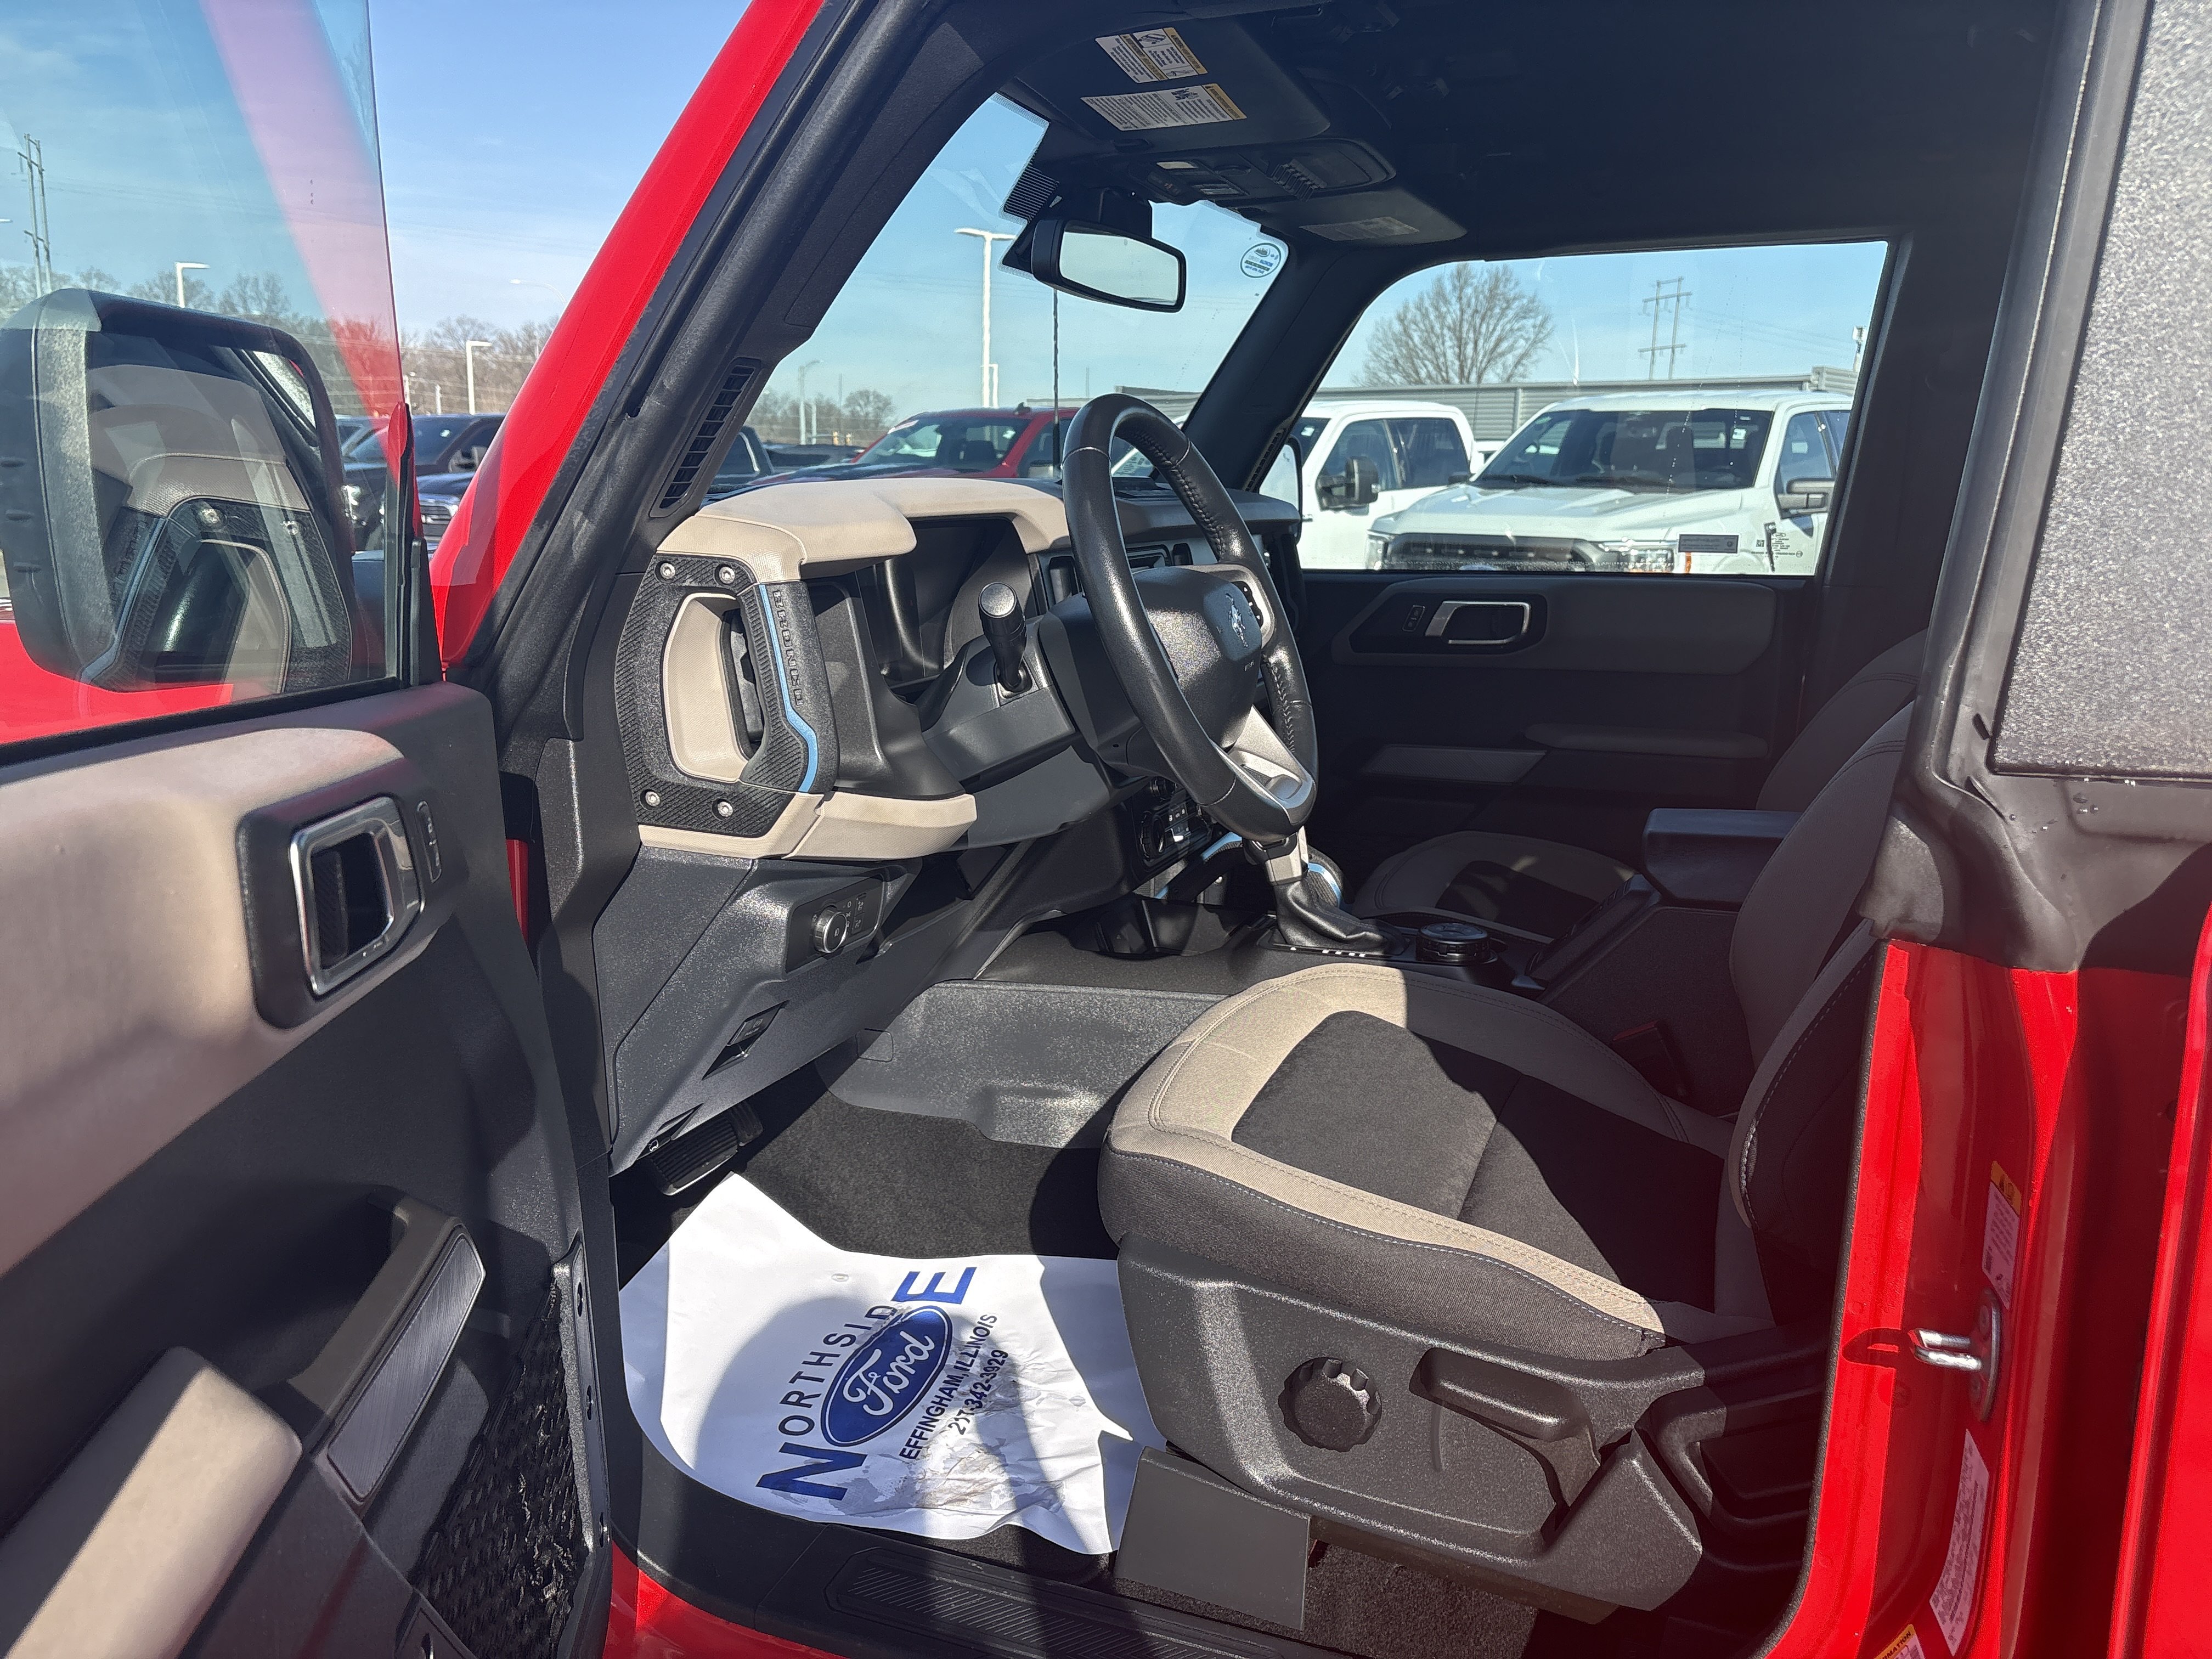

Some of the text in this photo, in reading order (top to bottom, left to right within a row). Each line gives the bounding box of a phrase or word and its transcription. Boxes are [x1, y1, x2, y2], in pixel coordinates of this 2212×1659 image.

[773, 590, 804, 706] BRONCO
[756, 1267, 977, 1500] NORTHSIDE
[843, 1331, 934, 1415] Ford
[899, 1314, 997, 1459] EFFINGHAM, ILLINOIS
[947, 1350, 1008, 1435] 217-342-3929
